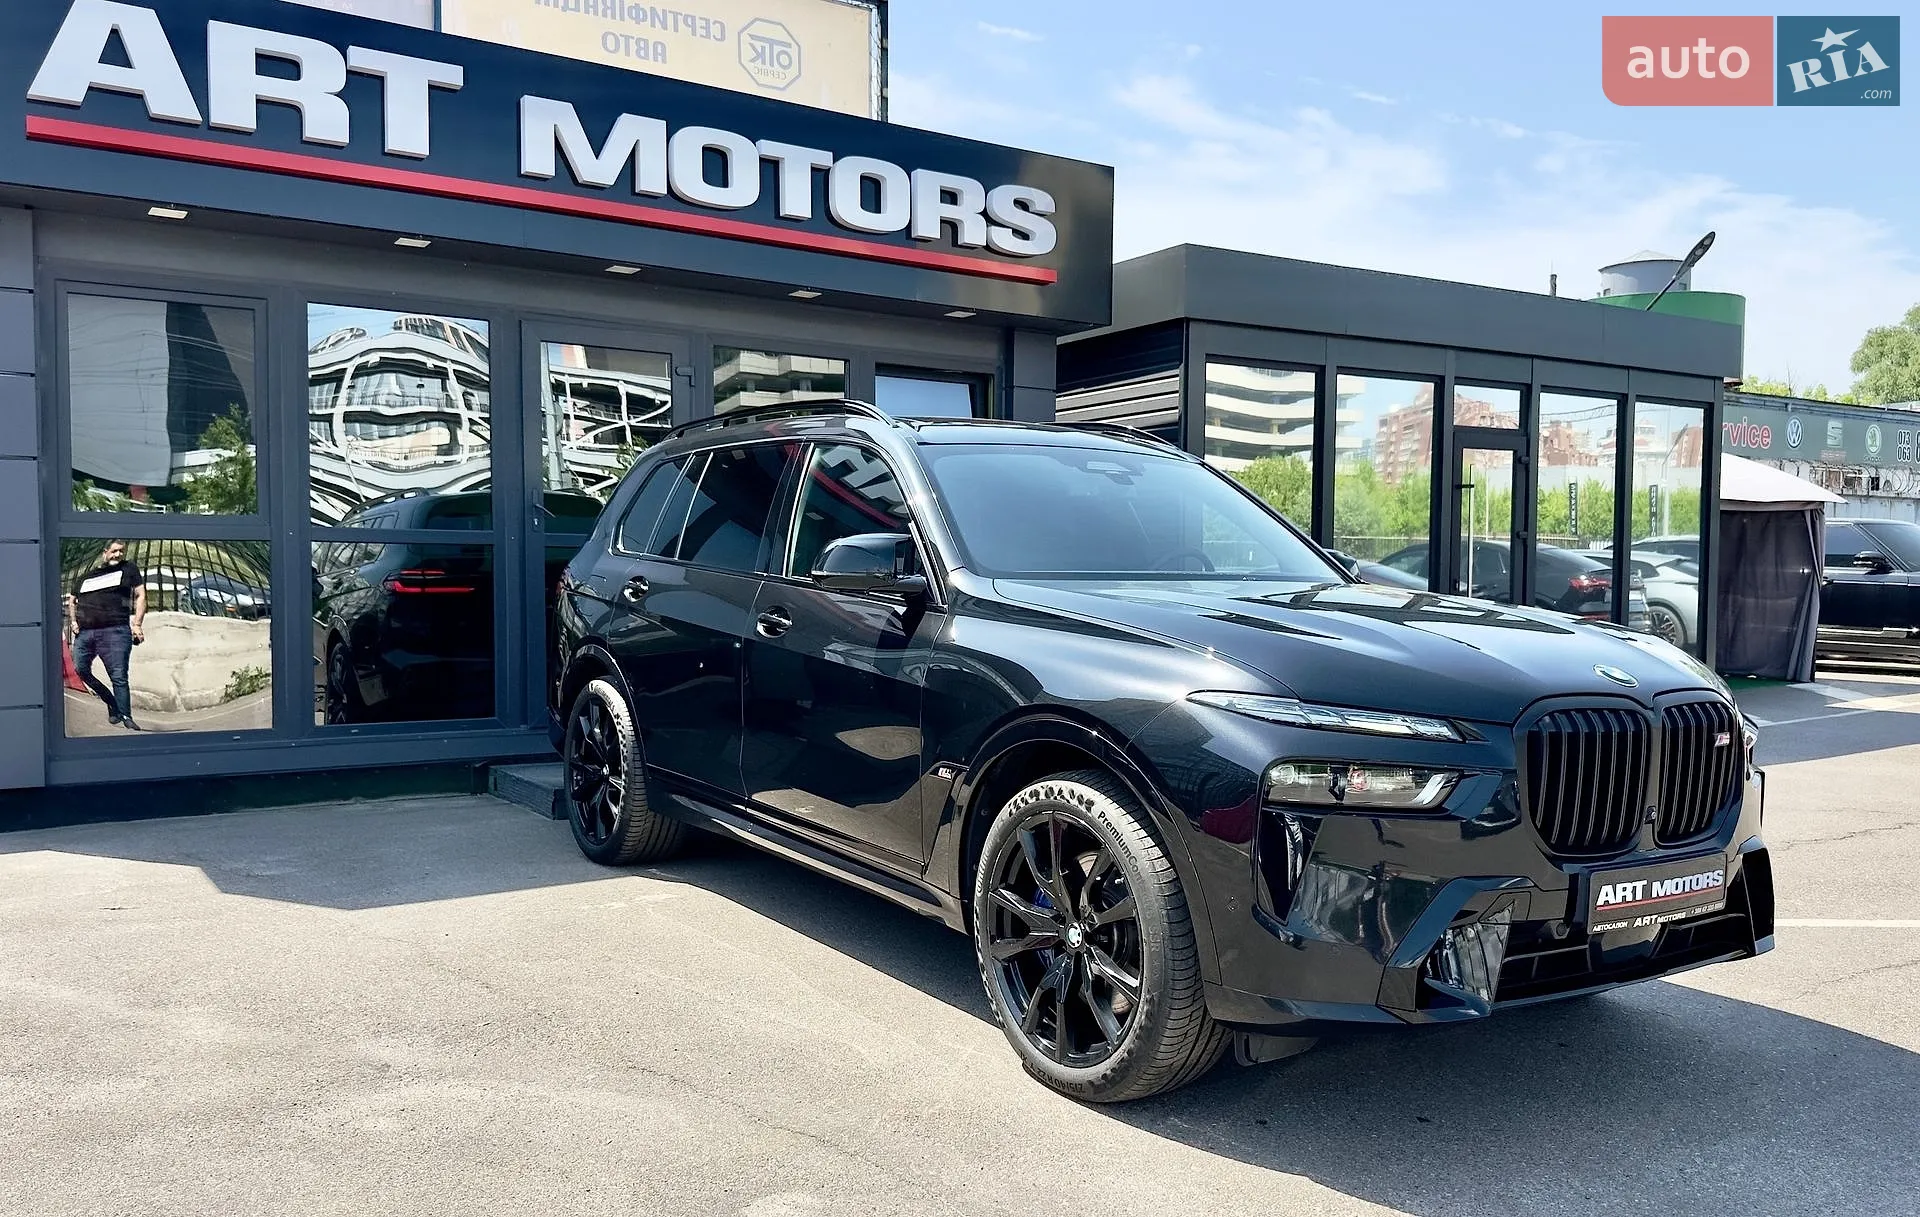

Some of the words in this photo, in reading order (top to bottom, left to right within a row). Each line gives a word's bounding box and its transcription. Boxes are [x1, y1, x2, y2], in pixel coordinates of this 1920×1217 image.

[26, 0, 464, 158] ART
[519, 94, 1057, 256] MOTORS
[1897, 430, 1911, 446] 073
[1897, 446, 1911, 462] 063
[1596, 880, 1648, 906] ART
[1651, 869, 1724, 898] MOTORS
